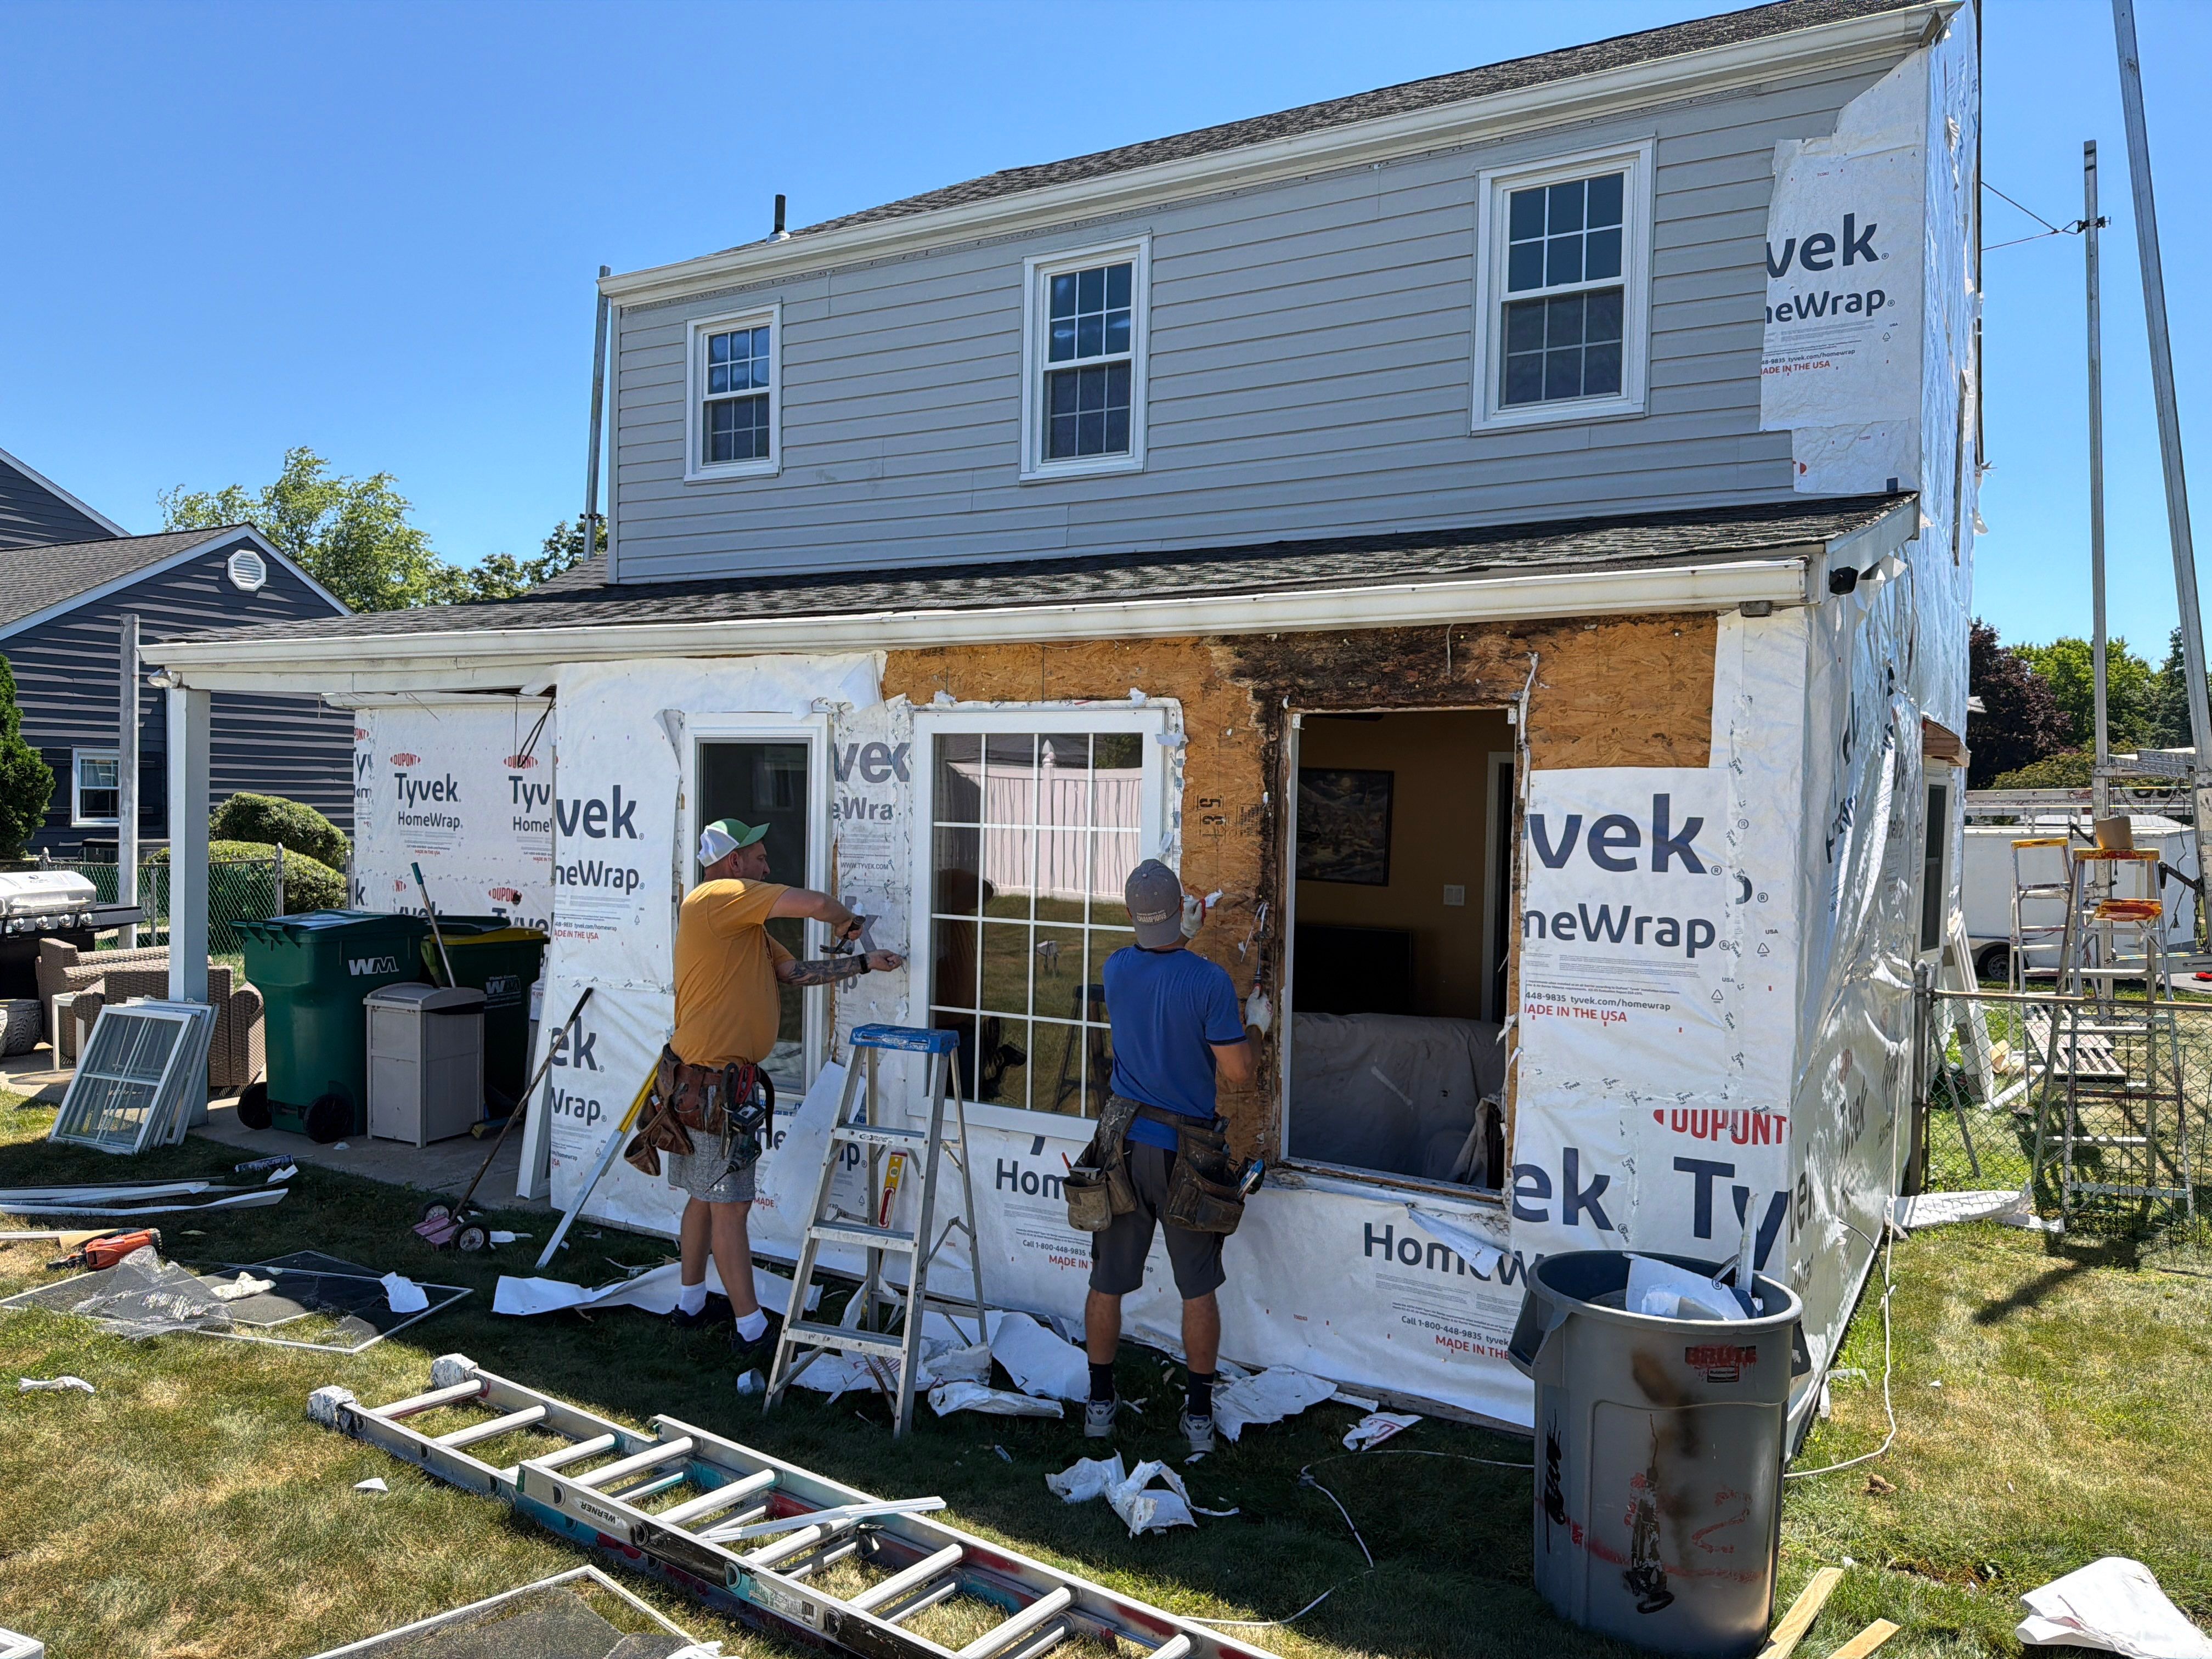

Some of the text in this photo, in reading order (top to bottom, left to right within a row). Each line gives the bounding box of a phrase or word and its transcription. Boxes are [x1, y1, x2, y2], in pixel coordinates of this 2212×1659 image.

[1788, 349, 1855, 362] tyvek.com/homewrap
[1793, 362, 1810, 371] THE
[1813, 360, 1830, 369] USA
[393, 753, 417, 766] DUPONT
[1732, 759, 1743, 776] Tyvek
[394, 772, 458, 808] Tyvek
[509, 776, 550, 813] Tyv
[556, 785, 637, 839] vek
[398, 811, 460, 831] HomeWrap
[513, 816, 552, 832] Home
[1530, 793, 1707, 873] vek
[1726, 830, 1736, 848] Tyvek
[492, 887, 517, 902] DUPON
[1137, 912, 1167, 923] CHAMPIONS
[574, 923, 617, 932] tyvek.com/homewrap
[574, 930, 585, 939] THE
[586, 932, 599, 940] USA
[1525, 904, 1716, 958] neWrap
[348, 956, 399, 975] WM
[1571, 996, 1671, 1011] tyvek.com/homewrap
[1557, 1006, 1570, 1016] IN
[1573, 1007, 1598, 1019] THE
[1601, 1010, 1627, 1022] USA
[1725, 1013, 1735, 1030] Tyvek
[1565, 1081, 1581, 1090] Tyvek
[1677, 1091, 1695, 1102] Tyvek
[1626, 1158, 1636, 1176] Tyvek
[1513, 1147, 1615, 1231] ek
[754, 1197, 775, 1208] MADE
[1023, 1240, 1034, 1248] Call
[1036, 1242, 1086, 1256] 1-800-448-9835
[1049, 1255, 1088, 1269] MADE IN
[1401, 1316, 1417, 1325] Call
[1418, 1319, 1481, 1340] 1-800-448-9835
[1435, 1335, 1469, 1352] MADE
[1472, 1344, 1485, 1355] IN
[580, 1502, 616, 1523] WERNER
